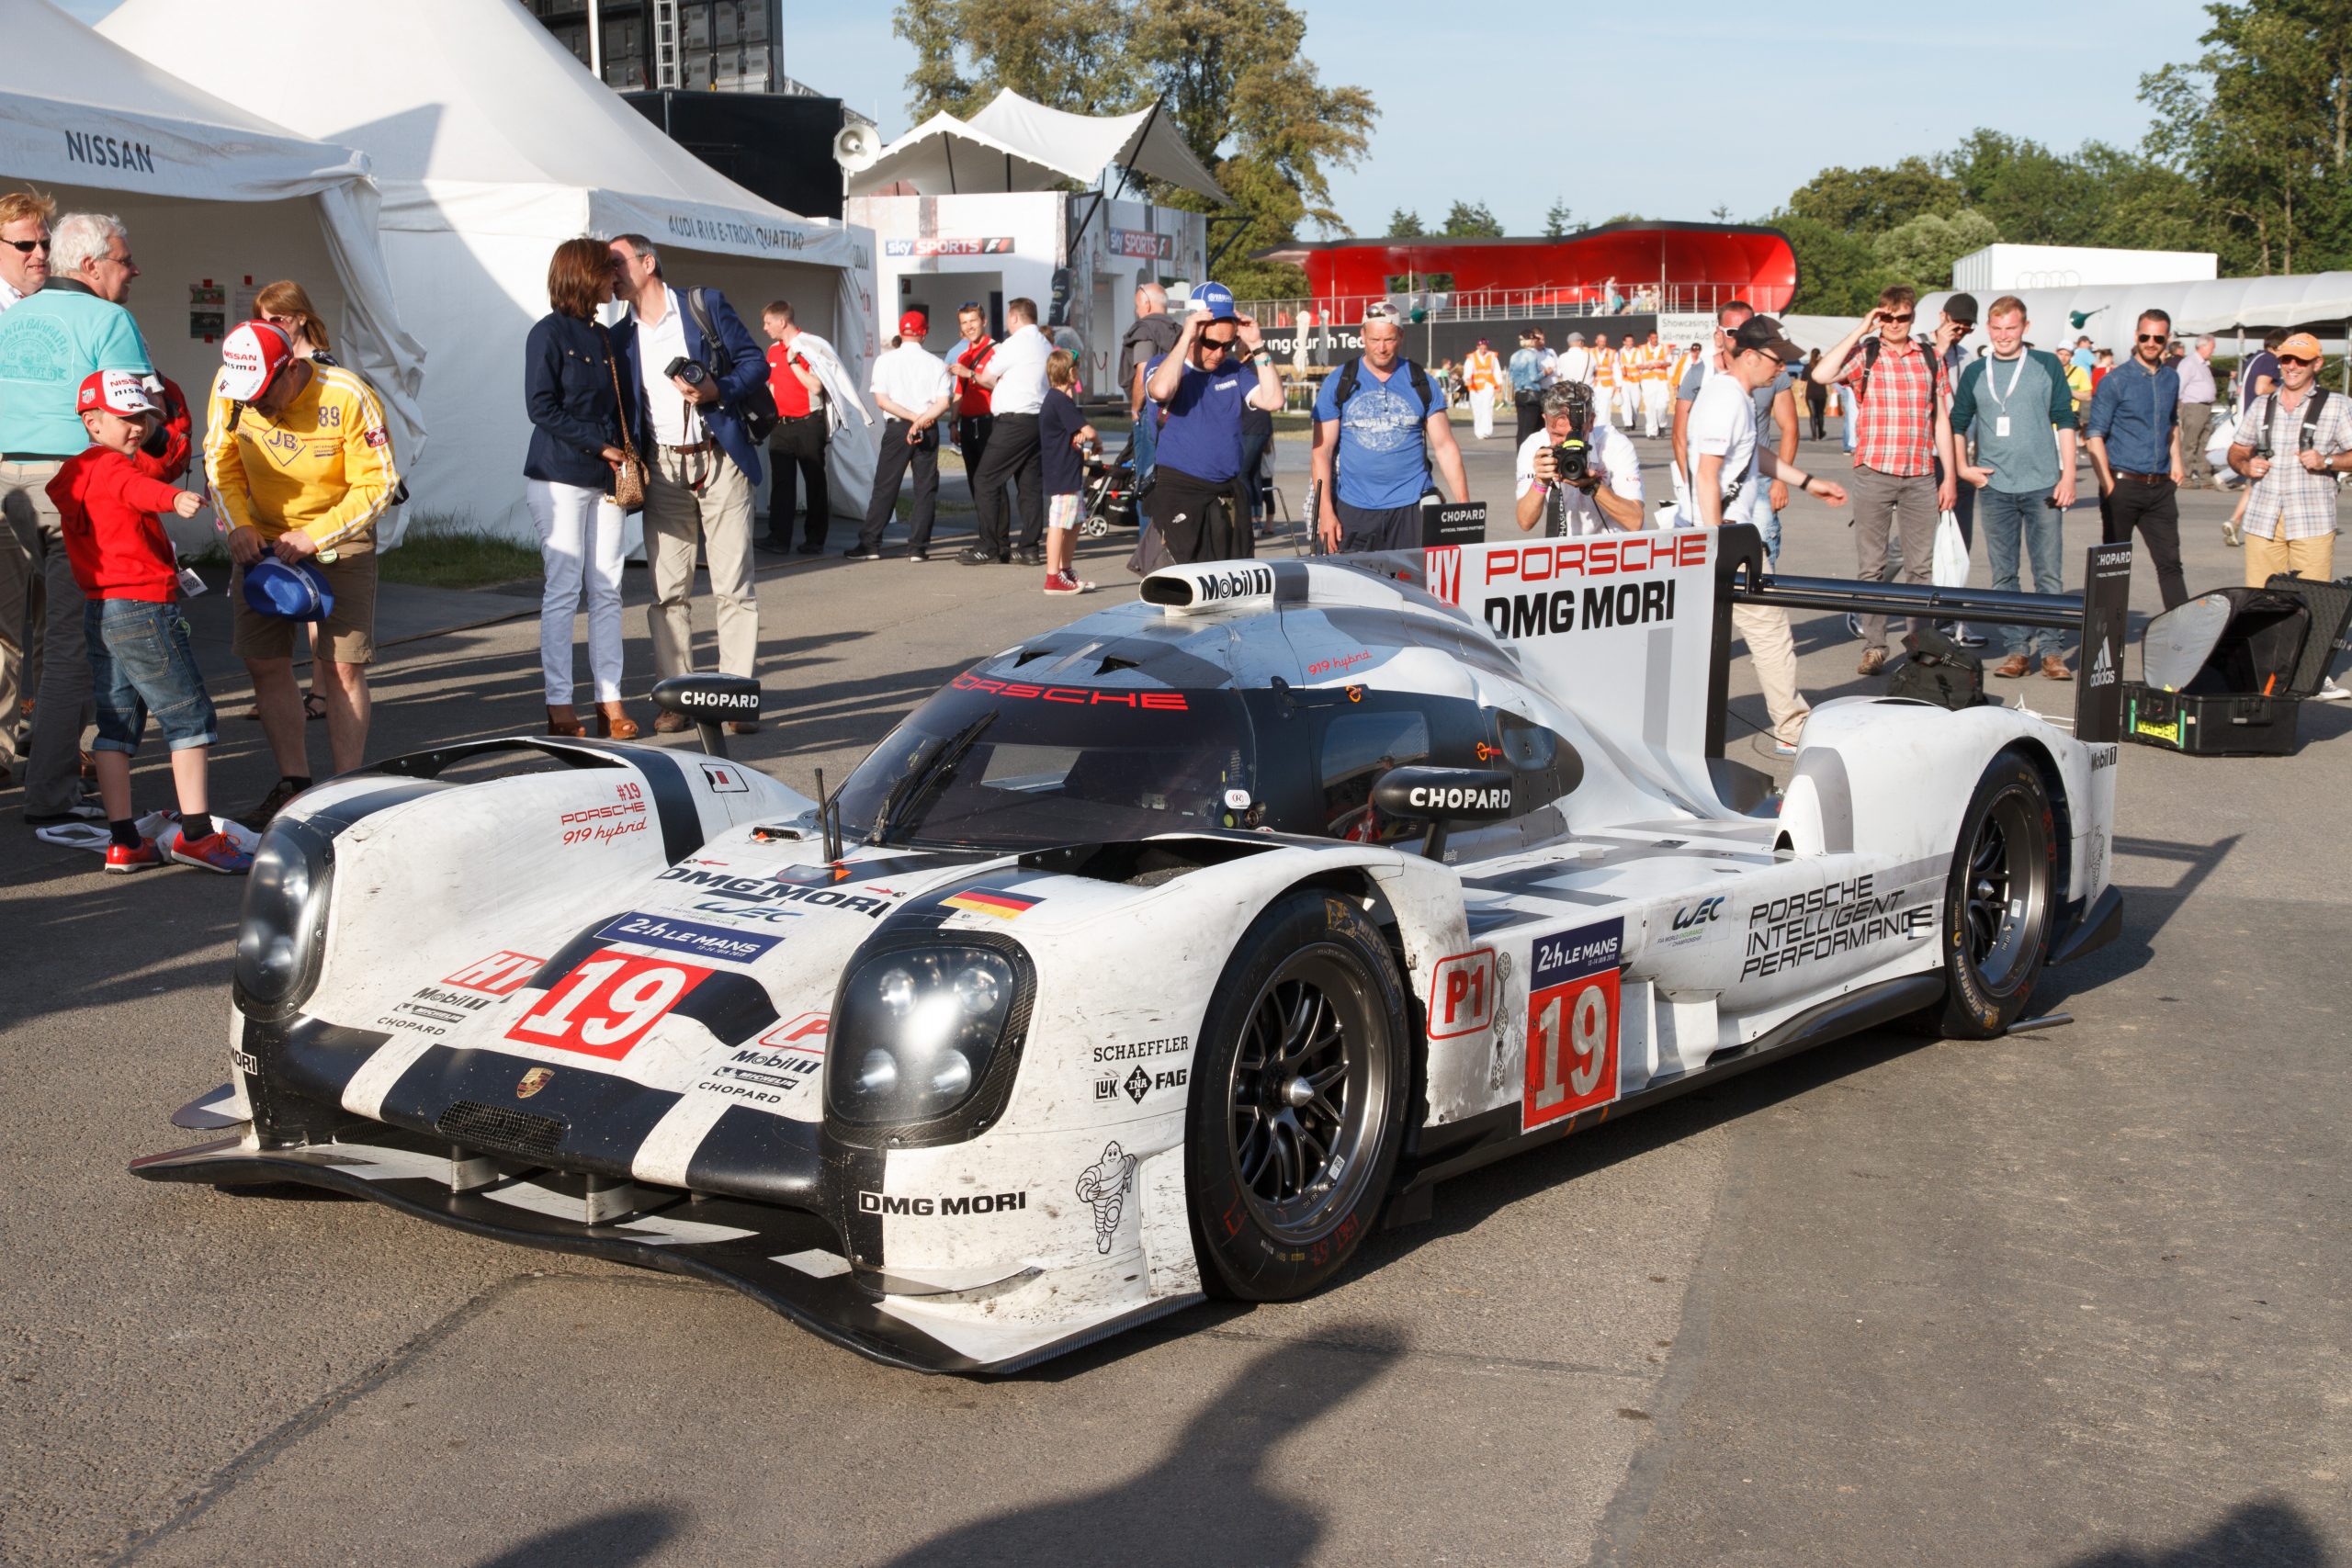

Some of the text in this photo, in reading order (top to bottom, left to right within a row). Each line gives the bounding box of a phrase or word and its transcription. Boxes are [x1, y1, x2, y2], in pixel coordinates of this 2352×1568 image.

[65, 130, 154, 174] NISSAN
[669, 214, 805, 250] AUDI R18 E-TRON QUATTRO
[1110, 229, 1123, 254] sky
[1125, 233, 1156, 255] SPORTS
[888, 240, 912, 255] sky
[916, 239, 980, 254] SPORTS
[1662, 319, 1709, 329] Showcasing
[1662, 332, 1691, 341] all-new
[318, 406, 340, 427] 89
[268, 431, 298, 451] JB
[1441, 509, 1485, 523] CHOPARD
[1486, 534, 1707, 585] PORSCHE
[1196, 569, 1272, 601] Mobil 1
[1426, 549, 1461, 604] HY
[1485, 579, 1676, 639] DMG MORI
[1308, 649, 1373, 675] 919 hybrid
[2090, 668, 2115, 688] adidas
[681, 691, 759, 708] CHOPARD
[2091, 749, 2109, 772] Mobil
[616, 782, 641, 801] #19
[1409, 787, 1511, 808] CHOPARD
[560, 802, 646, 826] PORSCHE
[563, 817, 647, 845] 919 hybrid
[655, 868, 770, 892] DMG
[761, 883, 894, 919] MORI
[1749, 874, 1873, 930] PORSCHE
[692, 901, 805, 922] WEC
[1672, 896, 1724, 931] WEC
[1747, 889, 1905, 956] INTELLIGENT
[662, 931, 696, 942] LE
[691, 936, 762, 953] MANS
[1565, 947, 1581, 964] LE
[1582, 937, 1618, 960] MANS
[1740, 904, 1933, 983] PERFORMANCE
[447, 953, 545, 991] HY
[1956, 954, 1984, 1015] MICHELIN
[413, 987, 472, 1008] Mobil
[520, 958, 686, 1045] 19
[1444, 964, 1485, 1024] P1
[377, 1016, 447, 1036] CHOPARD
[730, 1050, 798, 1070] Mobil
[1093, 1036, 1189, 1063] SCHAEFFLER
[1536, 985, 1608, 1111] 19
[739, 1071, 797, 1088] MICHELIN
[1156, 1069, 1187, 1090] FAG
[698, 1082, 781, 1103] CHOPARD
[860, 1191, 1026, 1216] DMG MORI
